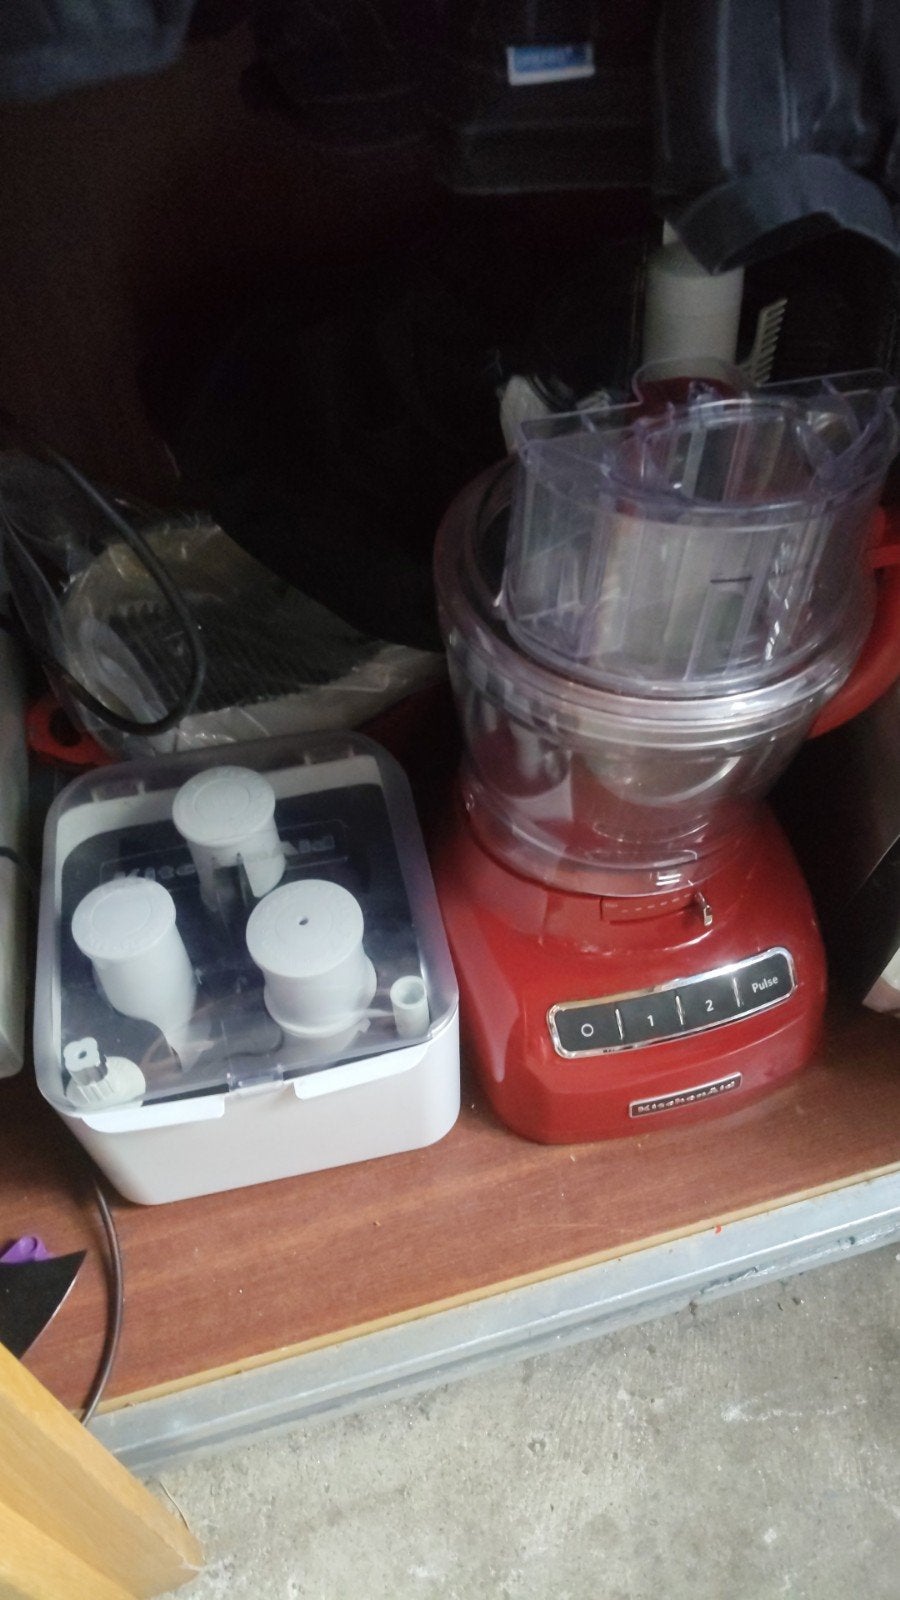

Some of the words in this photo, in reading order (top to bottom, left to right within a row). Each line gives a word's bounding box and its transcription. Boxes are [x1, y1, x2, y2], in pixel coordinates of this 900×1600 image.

[646, 1014, 654, 1027] 1
[705, 999, 715, 1012] 2
[751, 976, 779, 994] Pulse
